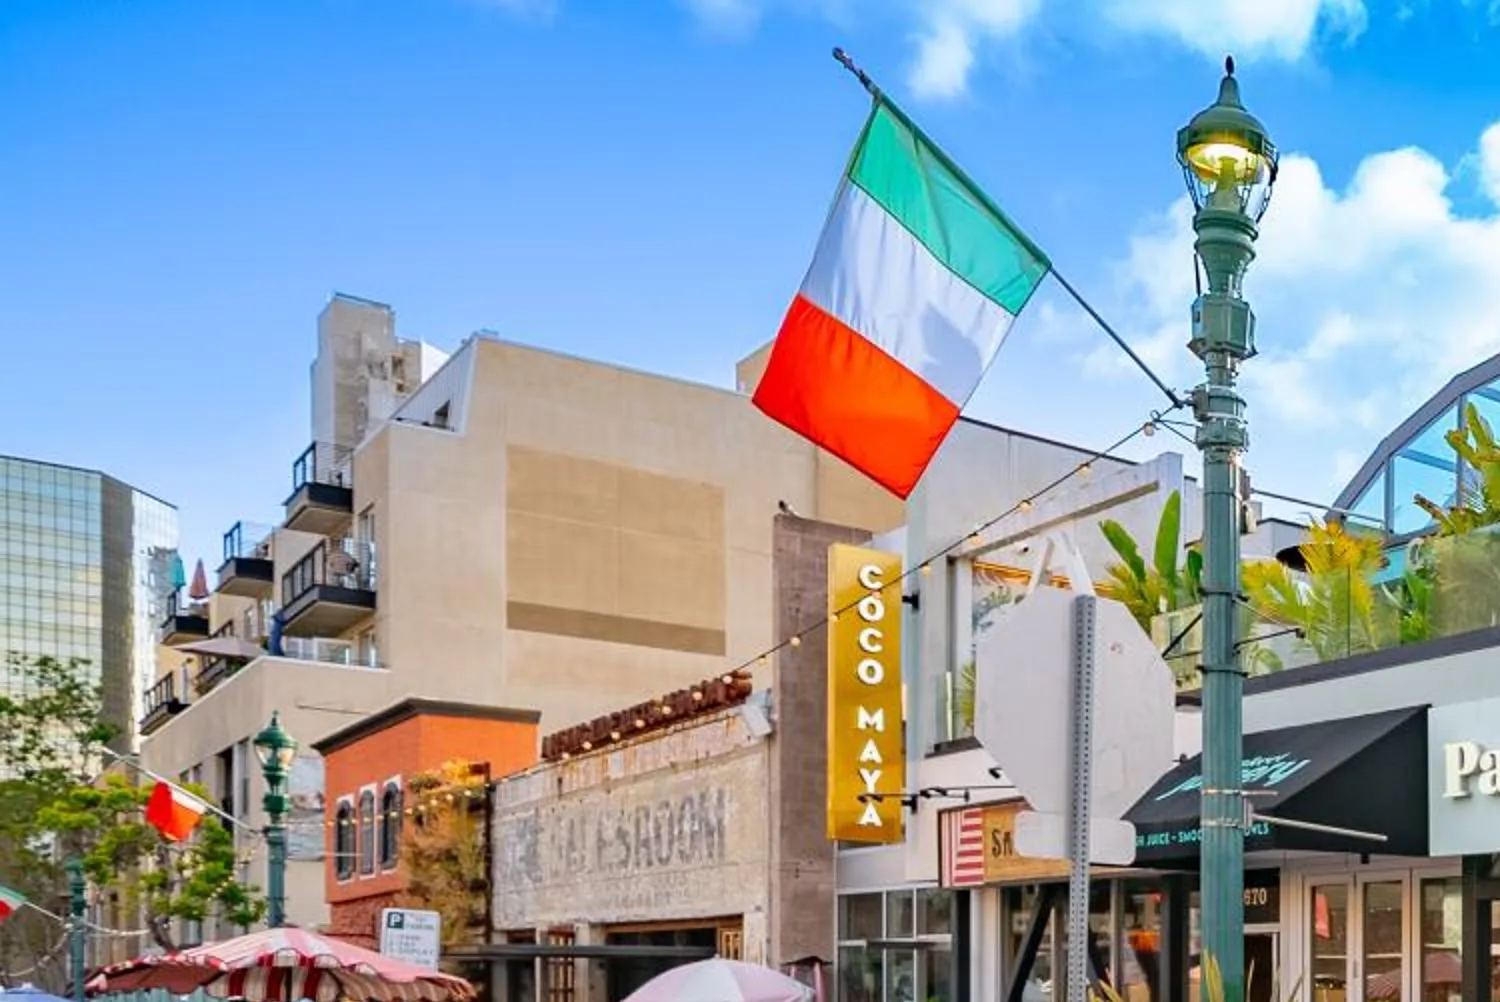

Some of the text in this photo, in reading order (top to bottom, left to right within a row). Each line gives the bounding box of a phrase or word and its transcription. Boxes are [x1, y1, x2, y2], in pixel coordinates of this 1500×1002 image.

[857, 563, 886, 828] COCO MAYA
[1147, 832, 1170, 846] JUICE
